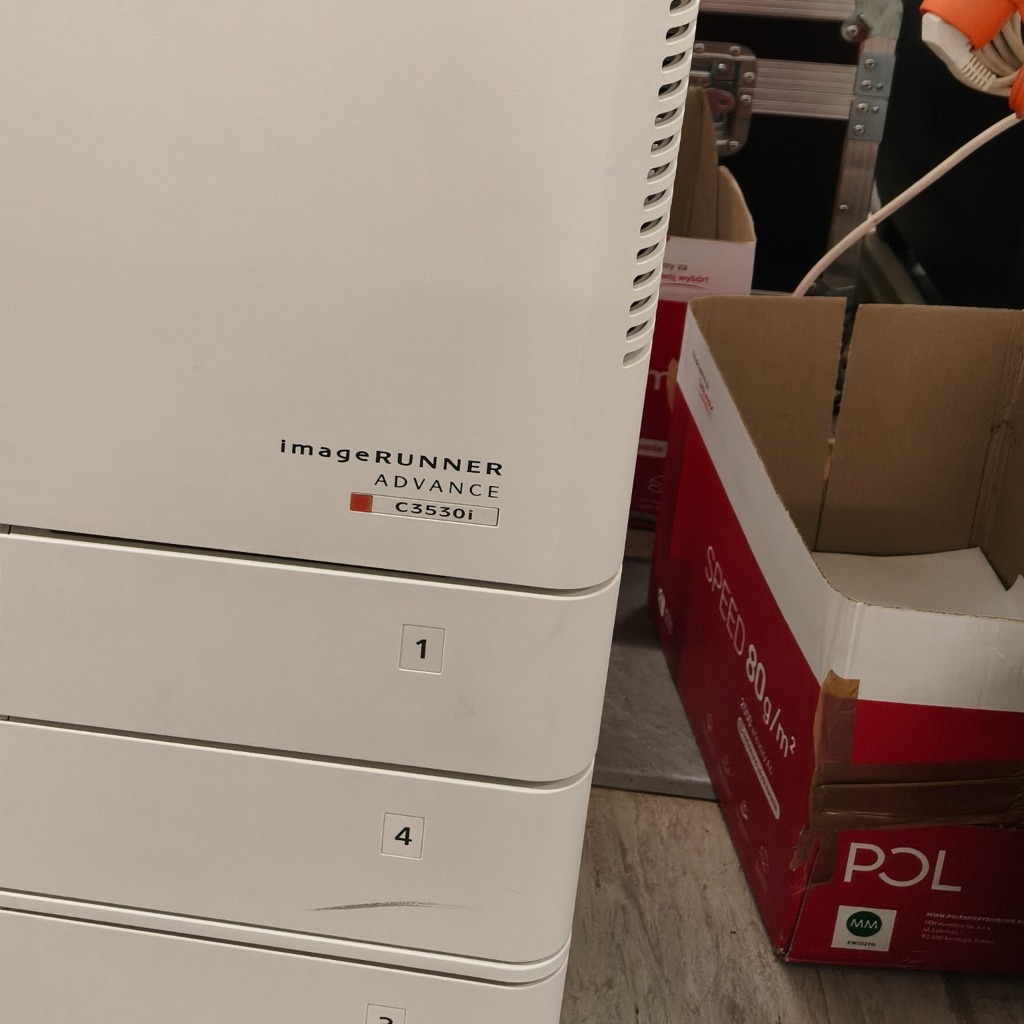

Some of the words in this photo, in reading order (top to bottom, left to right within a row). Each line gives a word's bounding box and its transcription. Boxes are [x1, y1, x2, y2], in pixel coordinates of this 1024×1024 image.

[280, 439, 502, 476] imageRUNNER
[374, 474, 499, 499] ADVANCE
[395, 501, 473, 520] C3530i
[705, 546, 745, 656] SPEED
[416, 638, 427, 659] 1
[394, 826, 412, 846] 4
[850, 918, 878, 930] MM
